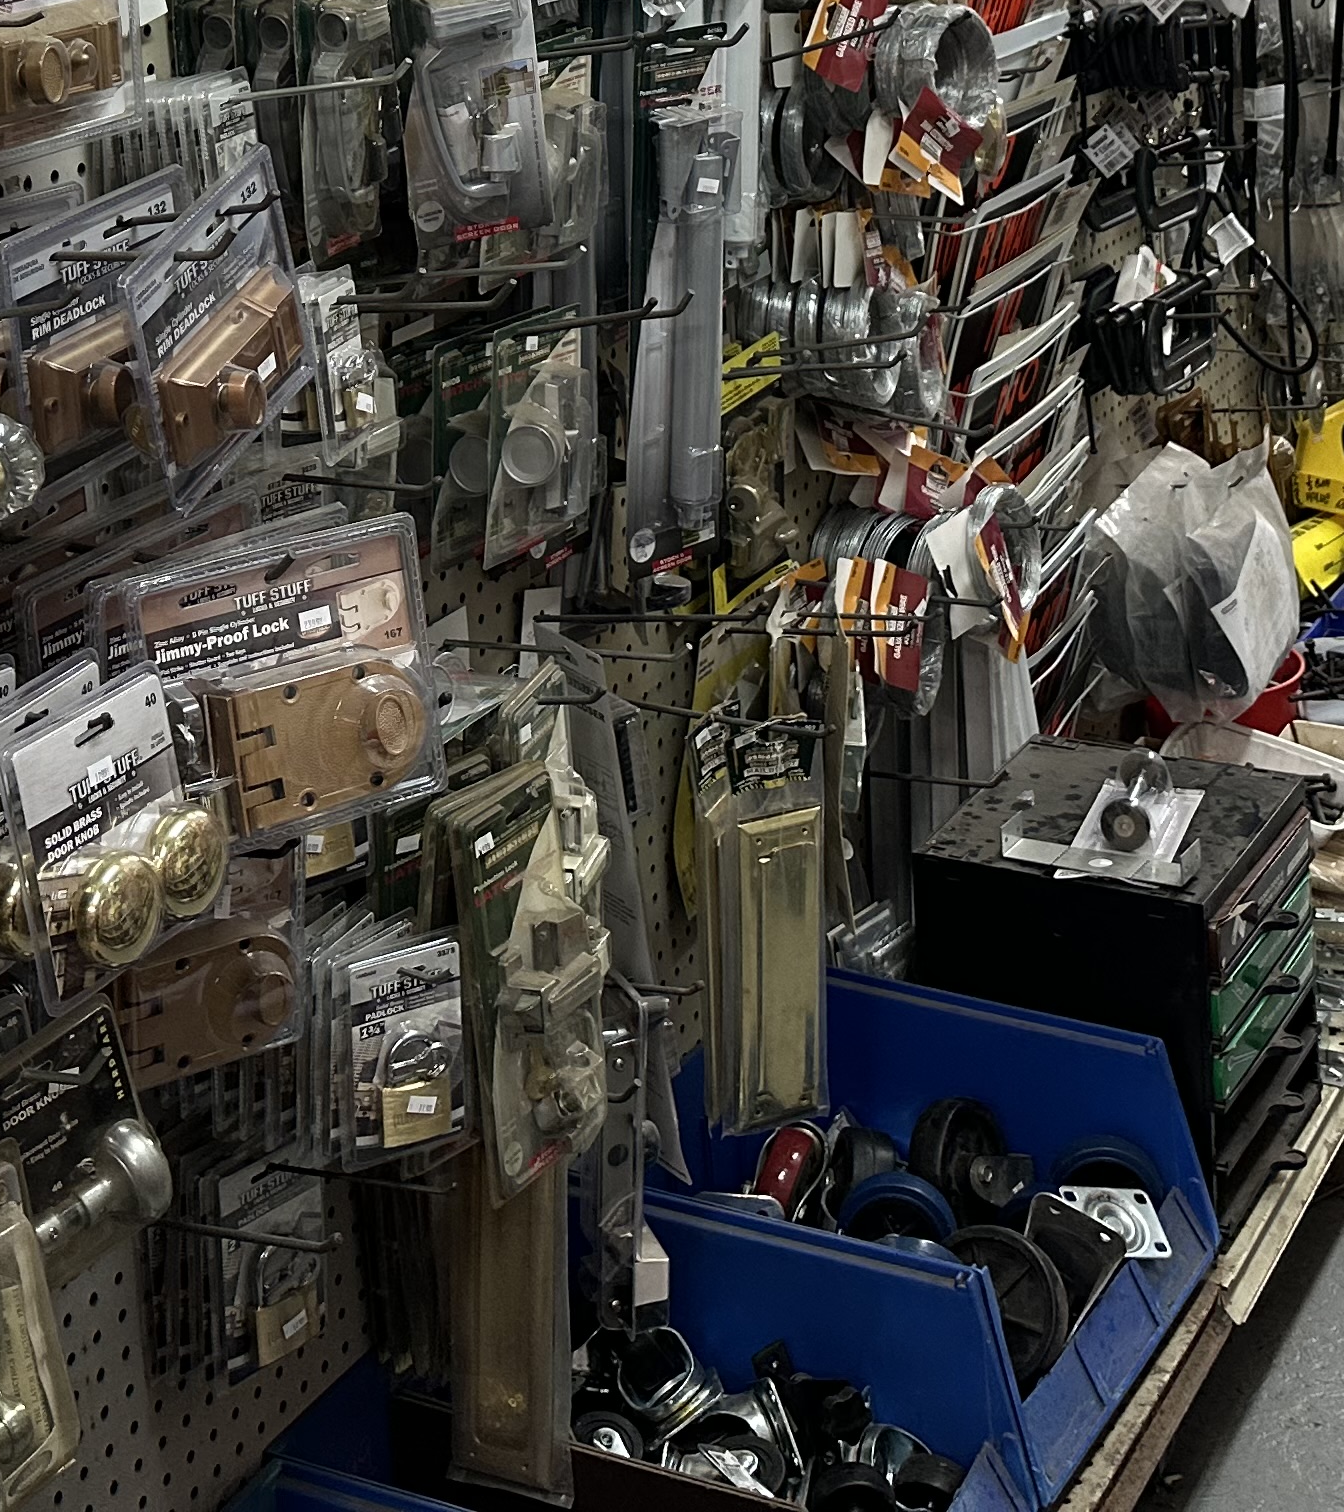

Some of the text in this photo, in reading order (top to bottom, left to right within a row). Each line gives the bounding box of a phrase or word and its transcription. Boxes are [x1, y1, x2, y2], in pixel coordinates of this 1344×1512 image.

[147, 201, 167, 216] 132
[31, 294, 106, 340] RIM DEADLOCK
[234, 579, 312, 611] TUFF STUFF
[155, 628, 249, 665] Jimmy-Proof
[252, 616, 290, 639] Lock
[384, 627, 403, 639] 167
[145, 692, 157, 707] 40
[44, 806, 103, 850] SOLID BRASS
[47, 824, 100, 863] DOOR KNOB
